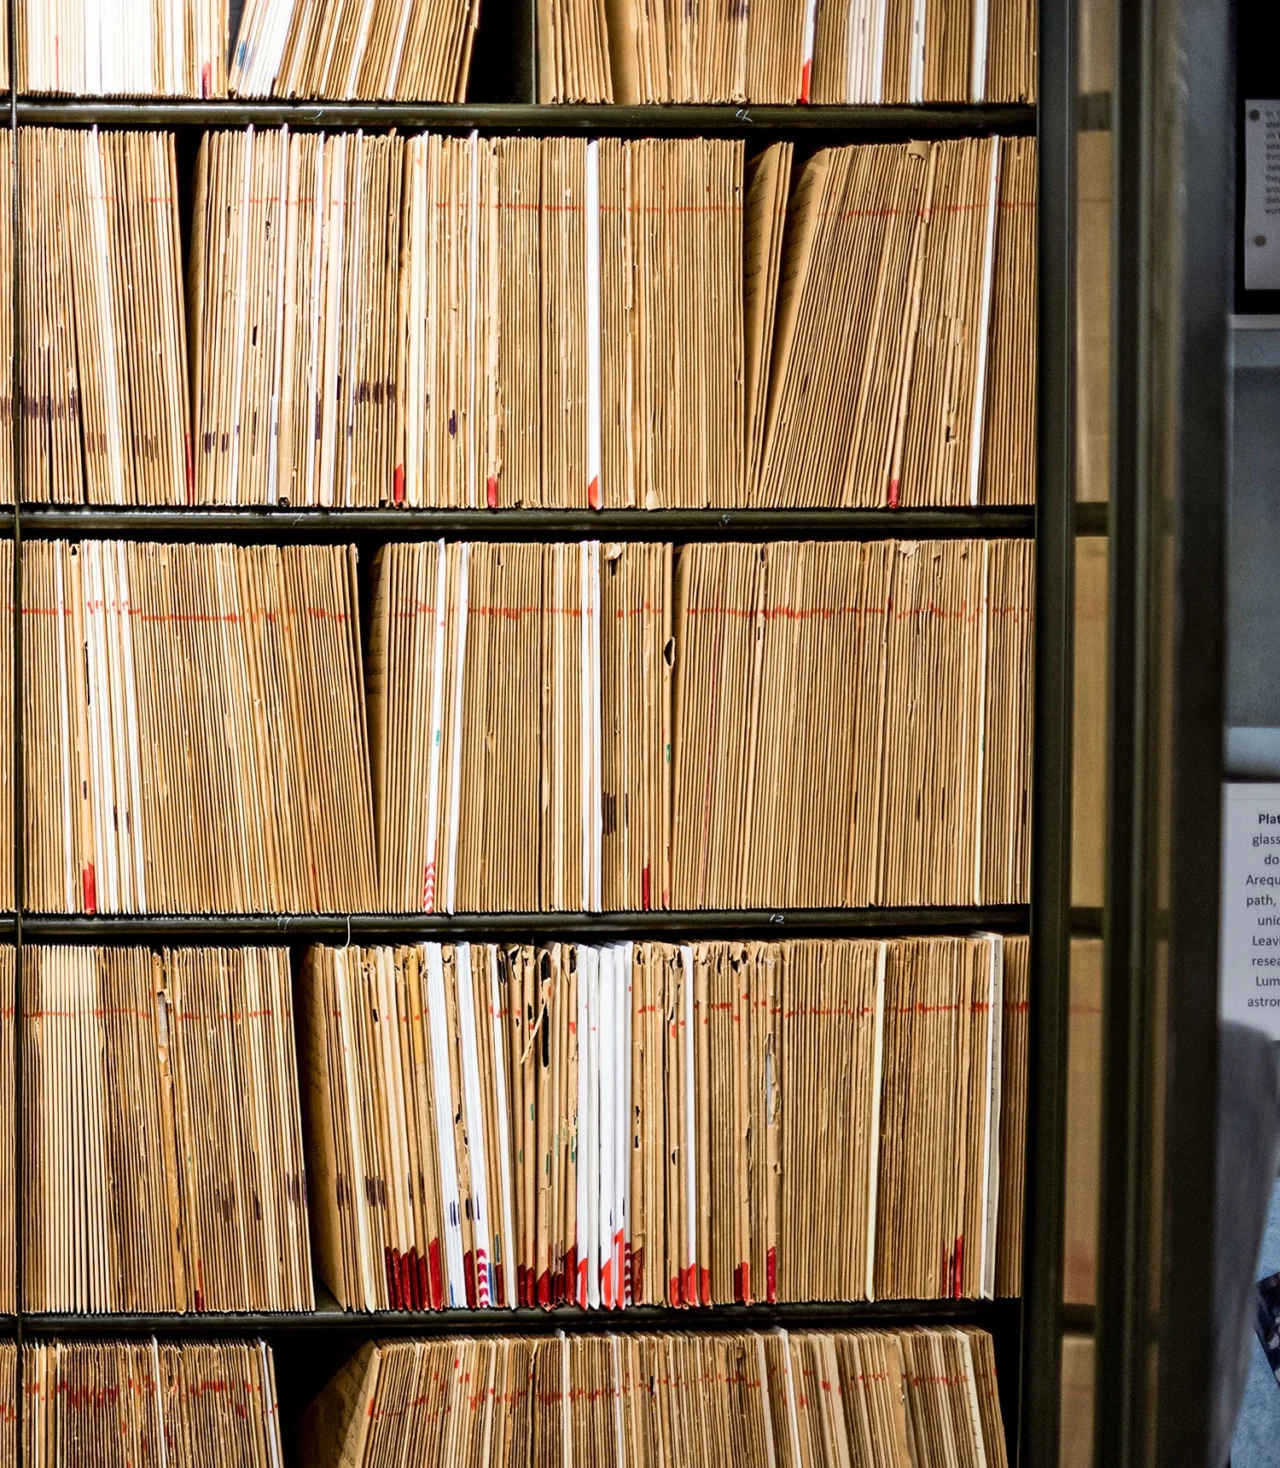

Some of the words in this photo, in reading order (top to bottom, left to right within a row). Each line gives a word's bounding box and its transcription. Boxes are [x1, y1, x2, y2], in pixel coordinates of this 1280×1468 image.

[1258, 813, 1280, 825] Plat
[1252, 833, 1280, 848] glass
[1264, 853, 1280, 865] do
[1245, 874, 1280, 888] Arequ
[1246, 894, 1277, 909] path,
[770, 913, 785, 925] 12
